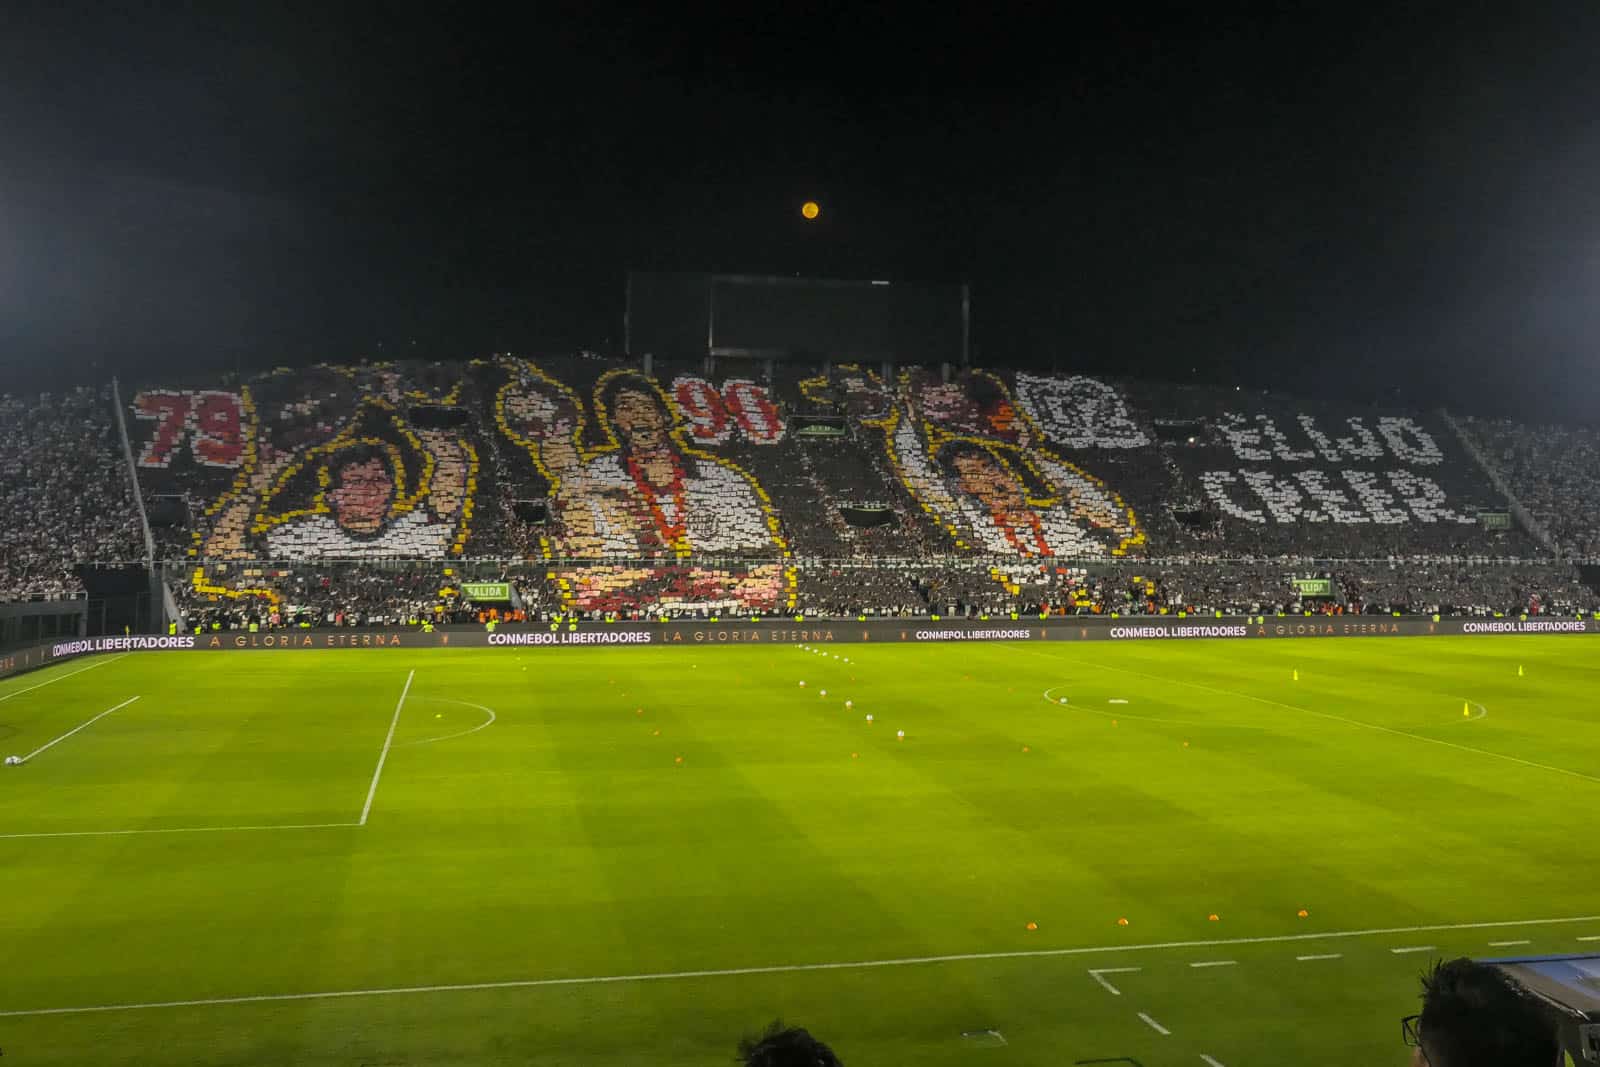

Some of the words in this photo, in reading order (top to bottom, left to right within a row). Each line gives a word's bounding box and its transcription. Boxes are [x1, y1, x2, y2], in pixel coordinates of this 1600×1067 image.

[672, 377, 786, 445] 90
[130, 389, 246, 468] 79
[1110, 627, 1170, 638] CONMEBOL
[1171, 626, 1247, 637] LIBERTADORES
[1463, 622, 1517, 632] CONMEBOL
[1518, 621, 1586, 632] LIBERTADORES
[235, 635, 313, 647] GLORIA
[327, 634, 401, 646] ETERNA
[487, 633, 559, 645] CONMEBOL
[561, 632, 651, 644] LIBERTADORES
[663, 631, 682, 641] LA
[694, 630, 760, 641] GLORIA
[771, 630, 833, 641] ETERNA
[967, 629, 1030, 639] LIBERTADORES
[53, 639, 95, 657] CONMEBOL
[95, 636, 195, 651] LIBERTADORES
